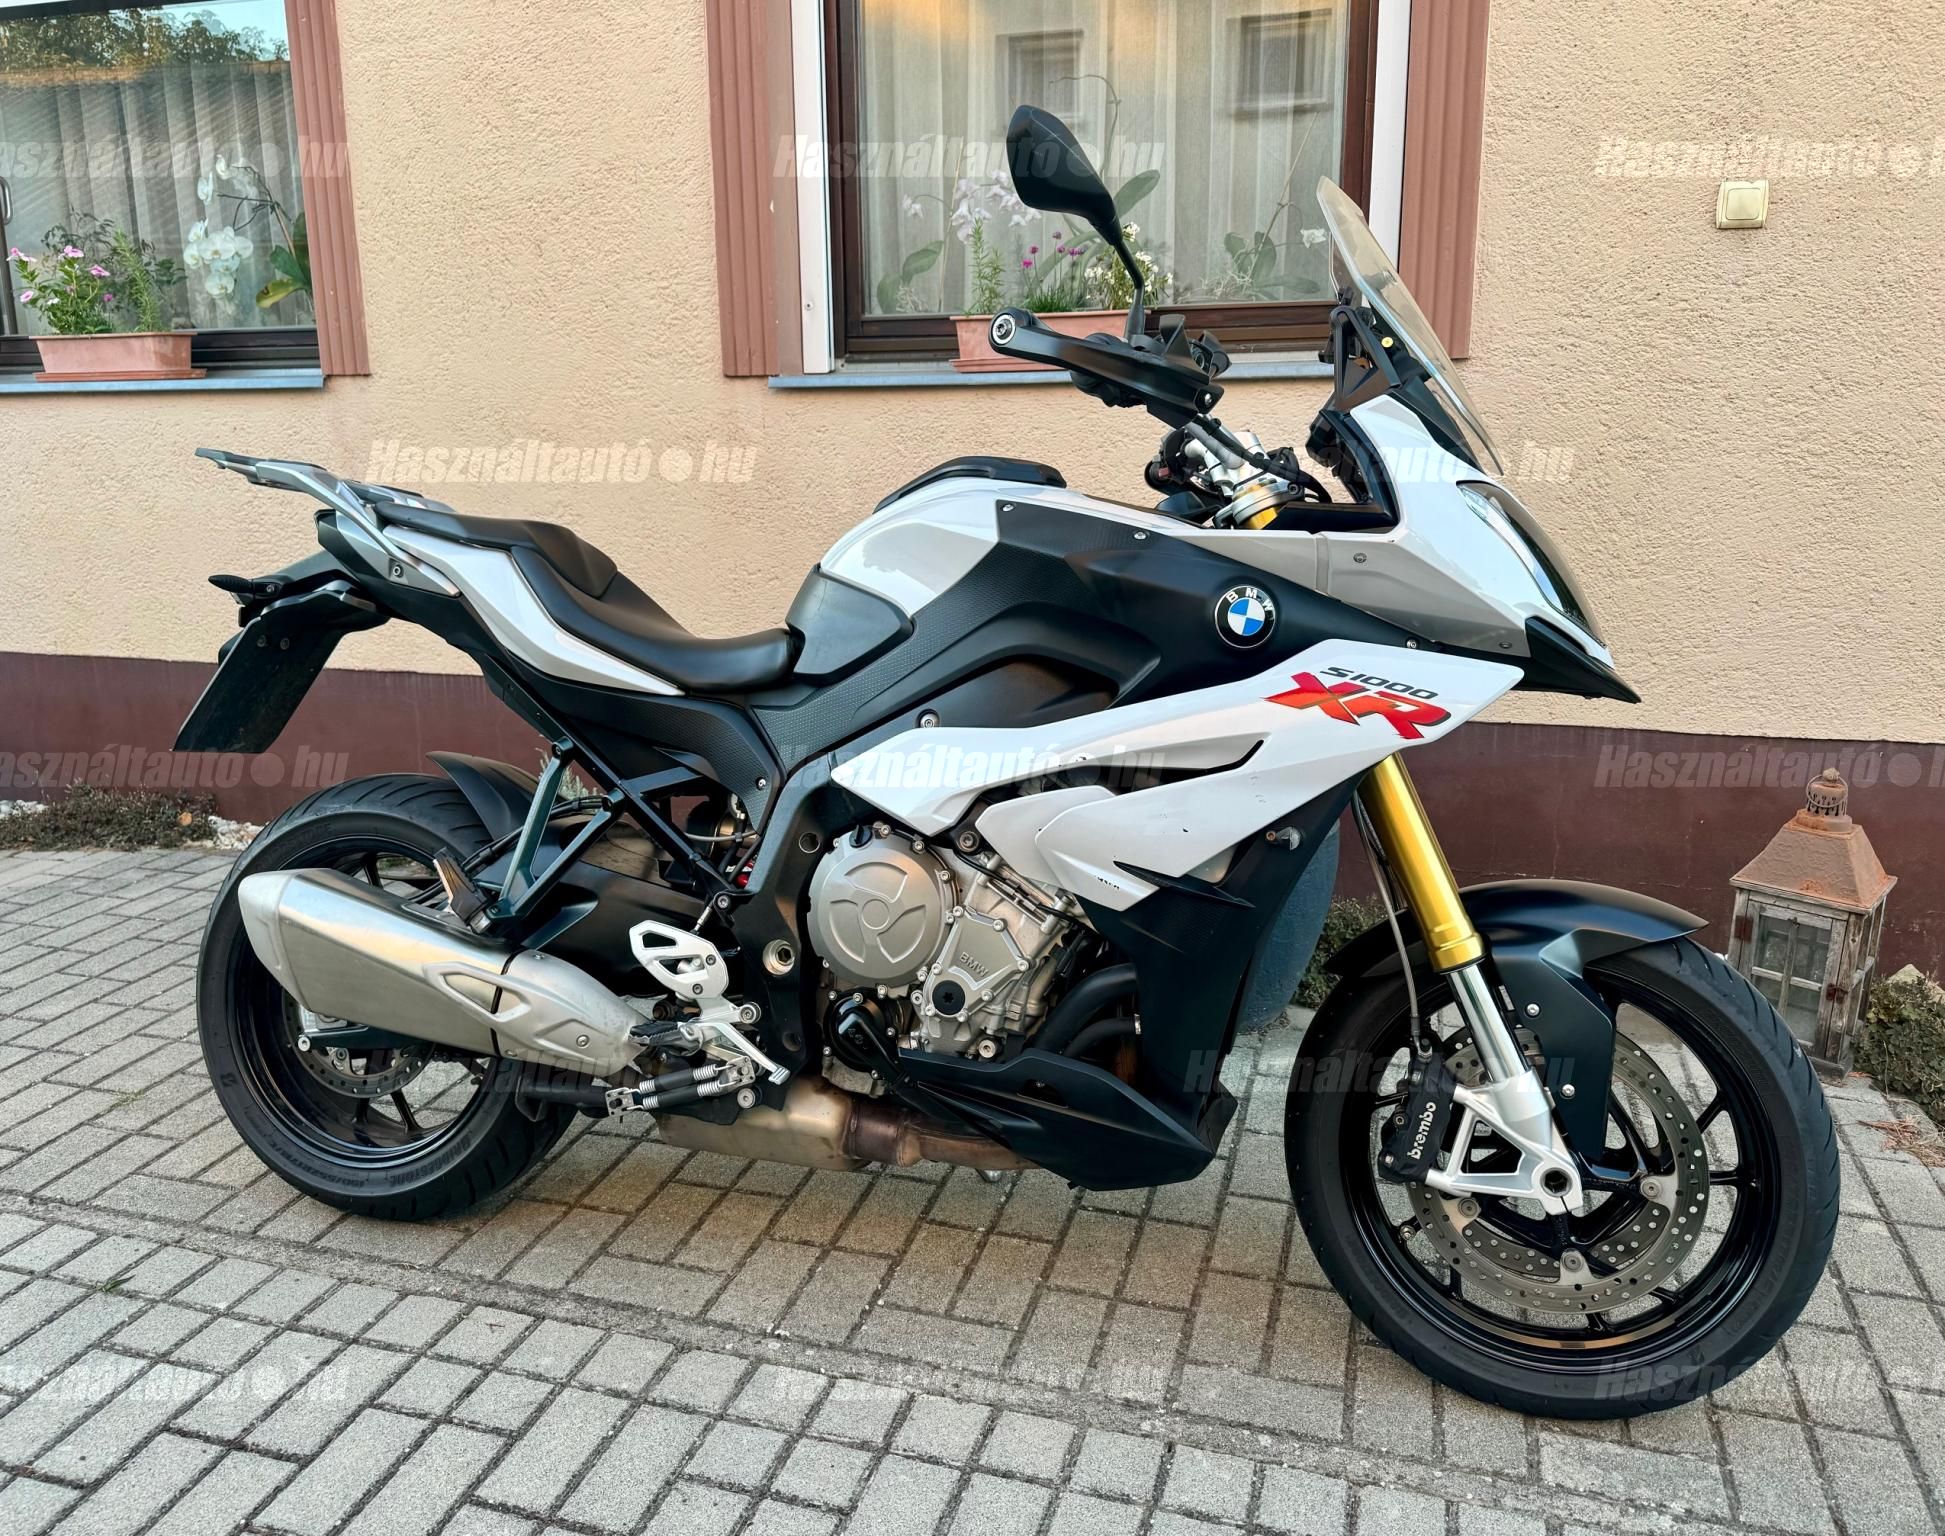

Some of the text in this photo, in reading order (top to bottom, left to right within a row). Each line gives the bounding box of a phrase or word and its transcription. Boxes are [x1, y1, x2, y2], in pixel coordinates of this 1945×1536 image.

[1225, 586, 1275, 613] BMW
[1319, 666, 1439, 700] S1000
[1261, 671, 1452, 740] XR
[960, 951, 989, 977] BMW
[1407, 1101, 1437, 1160] brembo
